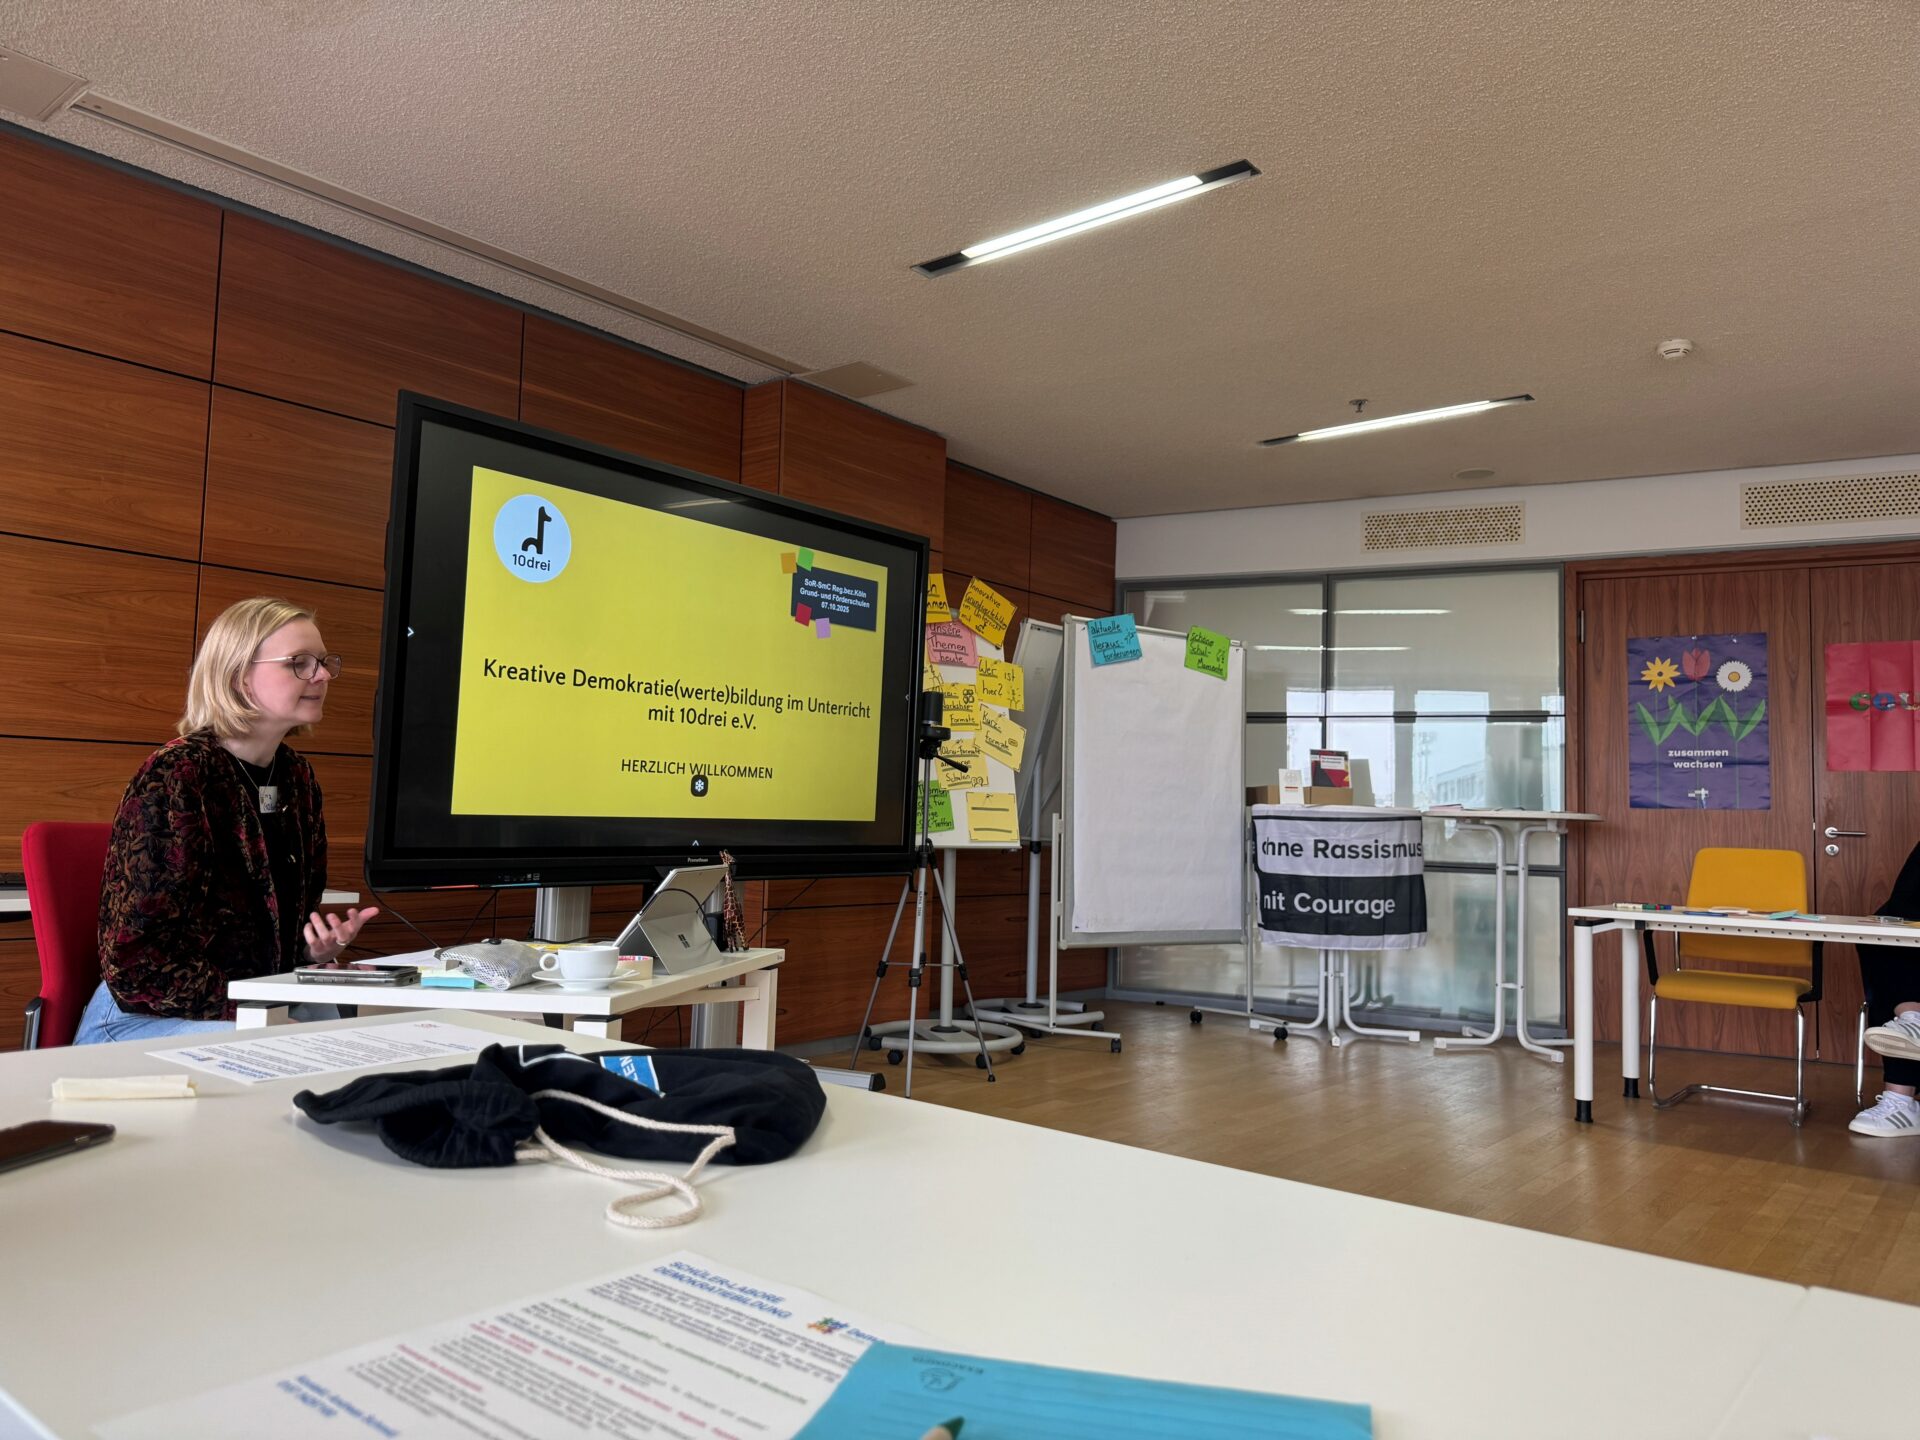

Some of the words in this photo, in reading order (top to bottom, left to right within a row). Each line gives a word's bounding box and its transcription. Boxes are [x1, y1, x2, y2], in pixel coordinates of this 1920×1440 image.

[512, 554, 551, 572] 10drei
[800, 587, 820, 597] Grund-
[804, 578, 832, 591] SoR-SmC
[821, 601, 850, 613] 07.10.2025
[1091, 621, 1121, 634] aktuelle
[979, 659, 998, 676] Wer
[1004, 669, 1016, 681] ist
[483, 658, 566, 685] Kreative
[572, 669, 784, 713] Demokratie(werte)bildung
[786, 695, 804, 711] im
[808, 697, 871, 719] Unterricht
[982, 680, 1003, 696] hier?
[648, 705, 675, 723] mit
[680, 708, 727, 728] 10drei
[731, 713, 757, 730] e.V.
[1668, 749, 1729, 757] zusammen
[621, 759, 686, 775] HERZLICH
[689, 763, 773, 779] WILLKOMMEN
[1673, 760, 1723, 769] wachsen
[1313, 838, 1422, 860] Rassismus
[1294, 892, 1395, 920] Courage
[669, 1260, 786, 1304] SCHÜLER-LABORE
[654, 1265, 793, 1319] DEMOKRATIEBILDUNG
